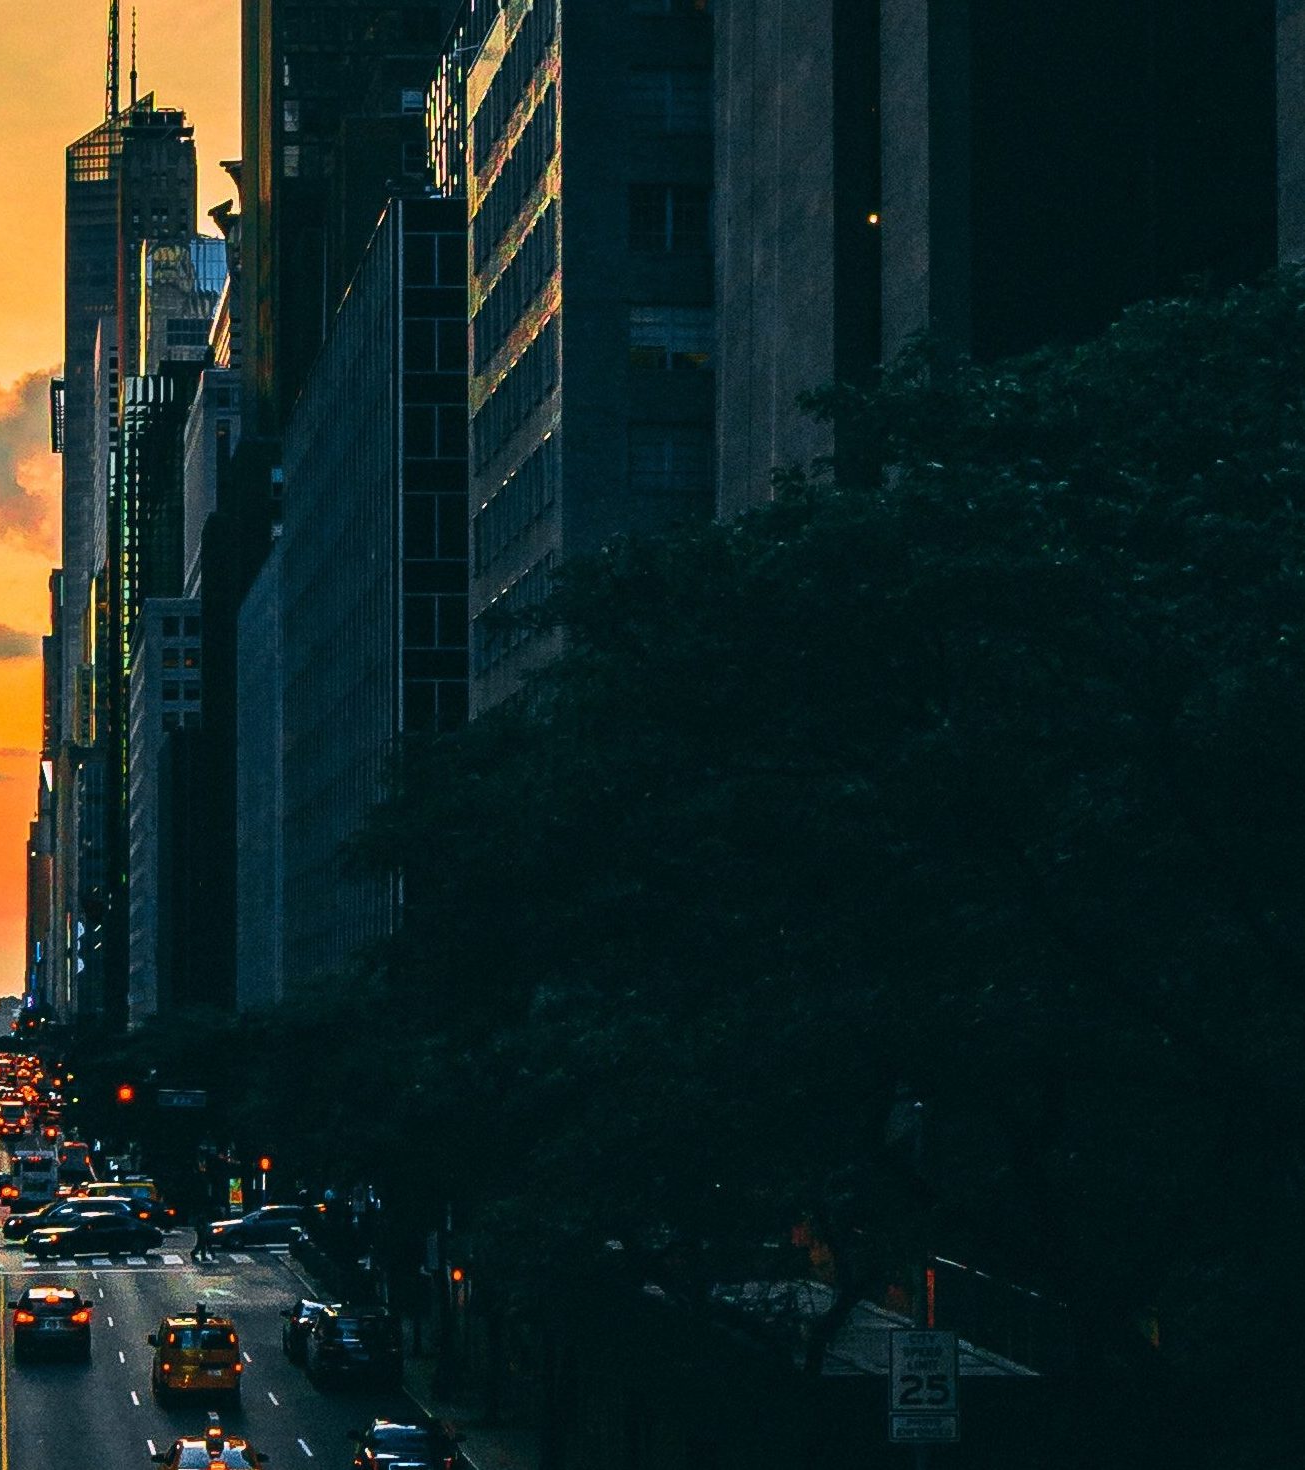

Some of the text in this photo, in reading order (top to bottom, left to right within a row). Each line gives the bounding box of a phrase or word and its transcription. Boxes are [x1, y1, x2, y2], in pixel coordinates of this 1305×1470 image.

[908, 1334, 937, 1344] CITY
[903, 1346, 942, 1357] SPEED
[907, 1360, 938, 1371] LIMIT
[899, 1374, 950, 1405] 25
